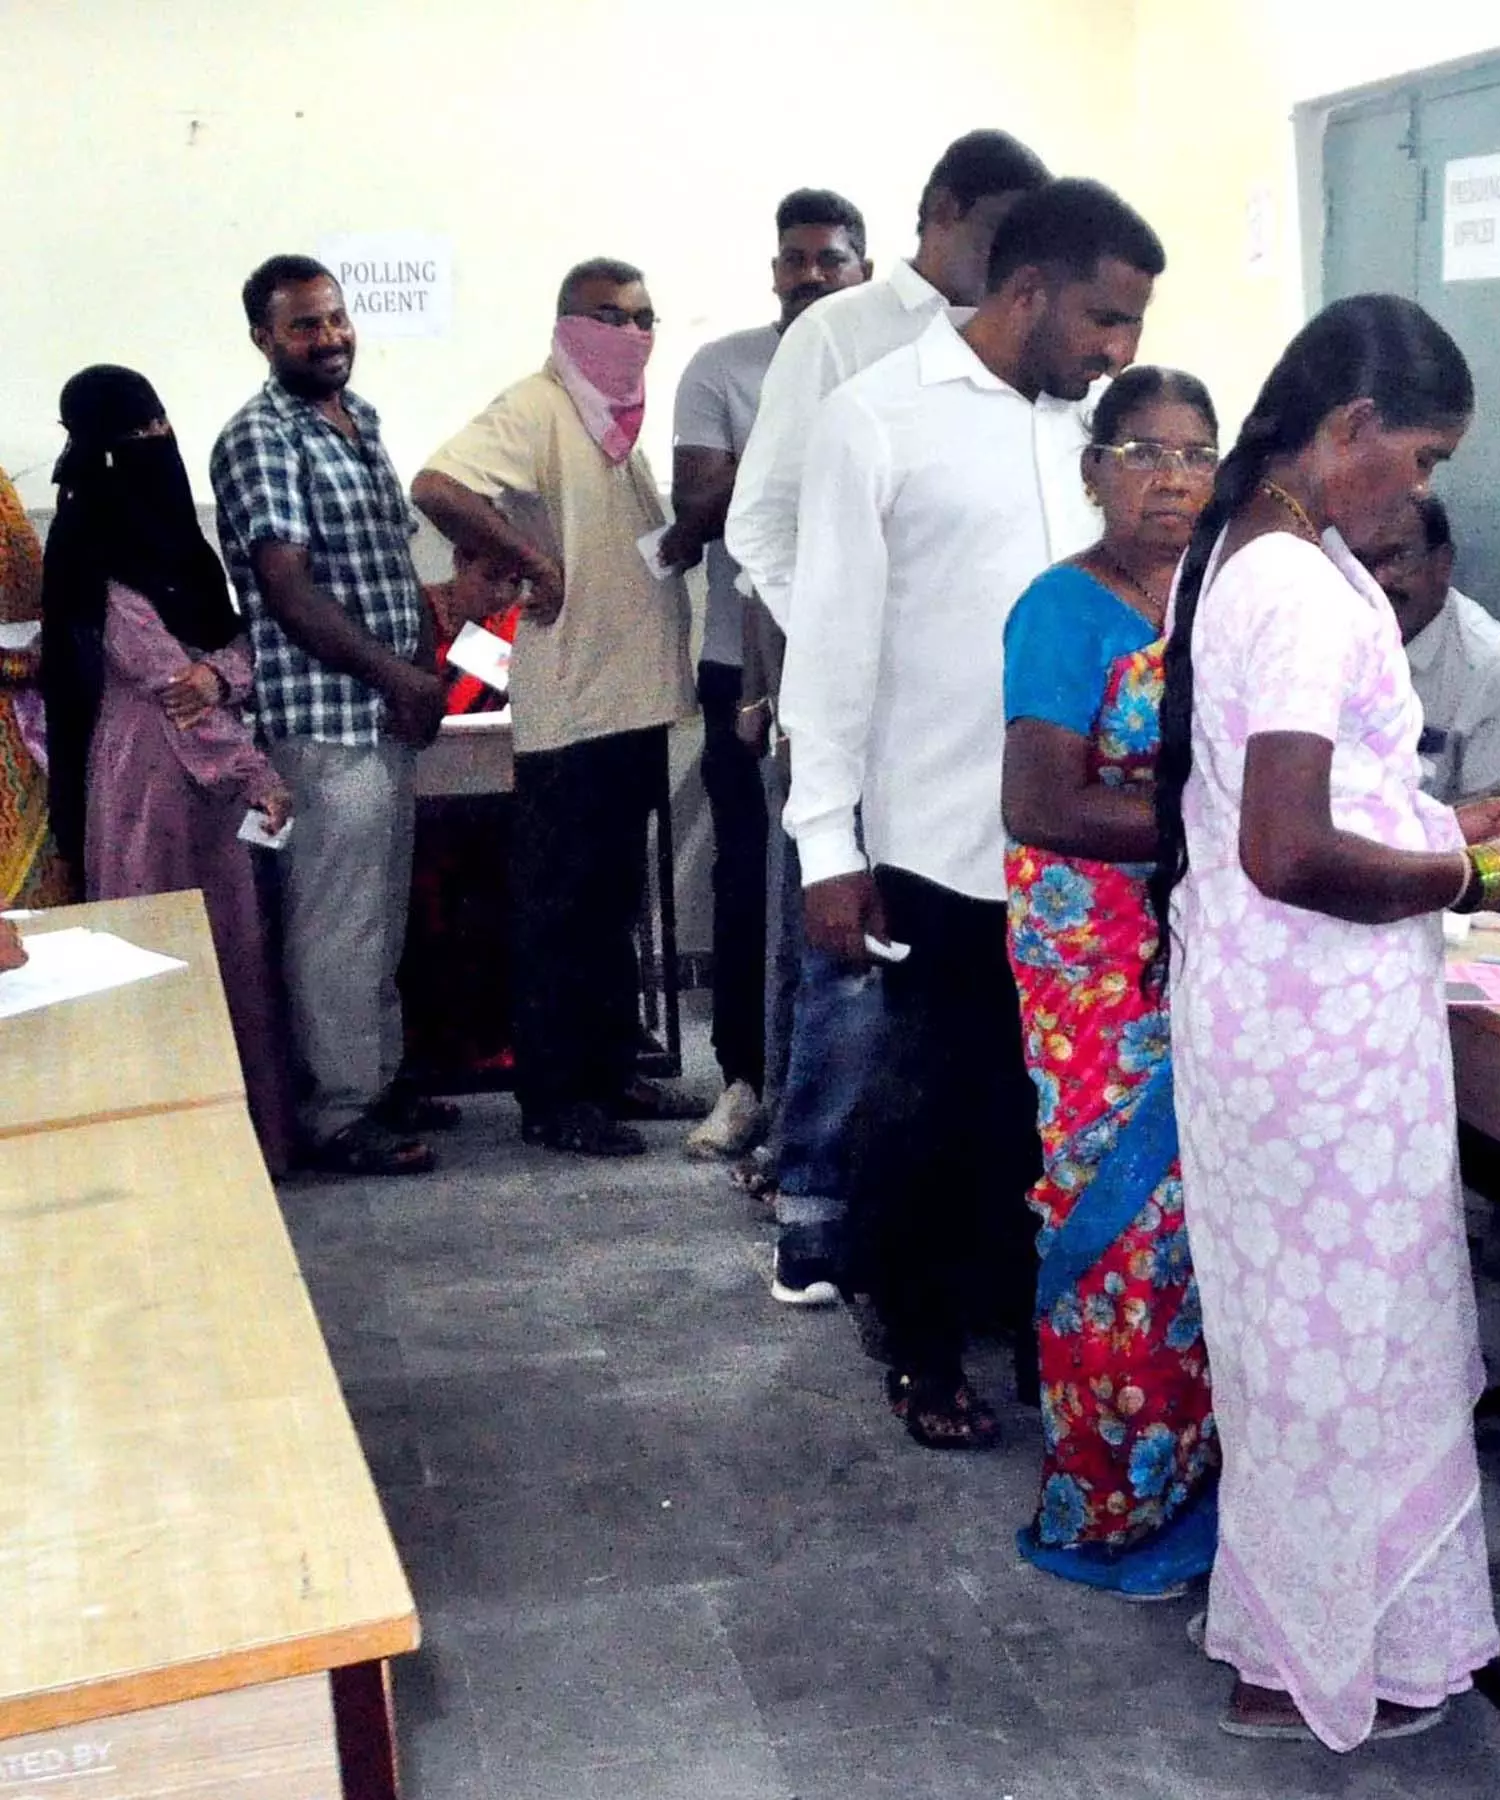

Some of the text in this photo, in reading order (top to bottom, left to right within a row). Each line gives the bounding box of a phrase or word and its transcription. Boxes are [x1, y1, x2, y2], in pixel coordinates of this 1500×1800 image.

[339, 259, 436, 285] POLLING
[351, 290, 429, 314] AGENT
[73, 1741, 112, 1767] BY
